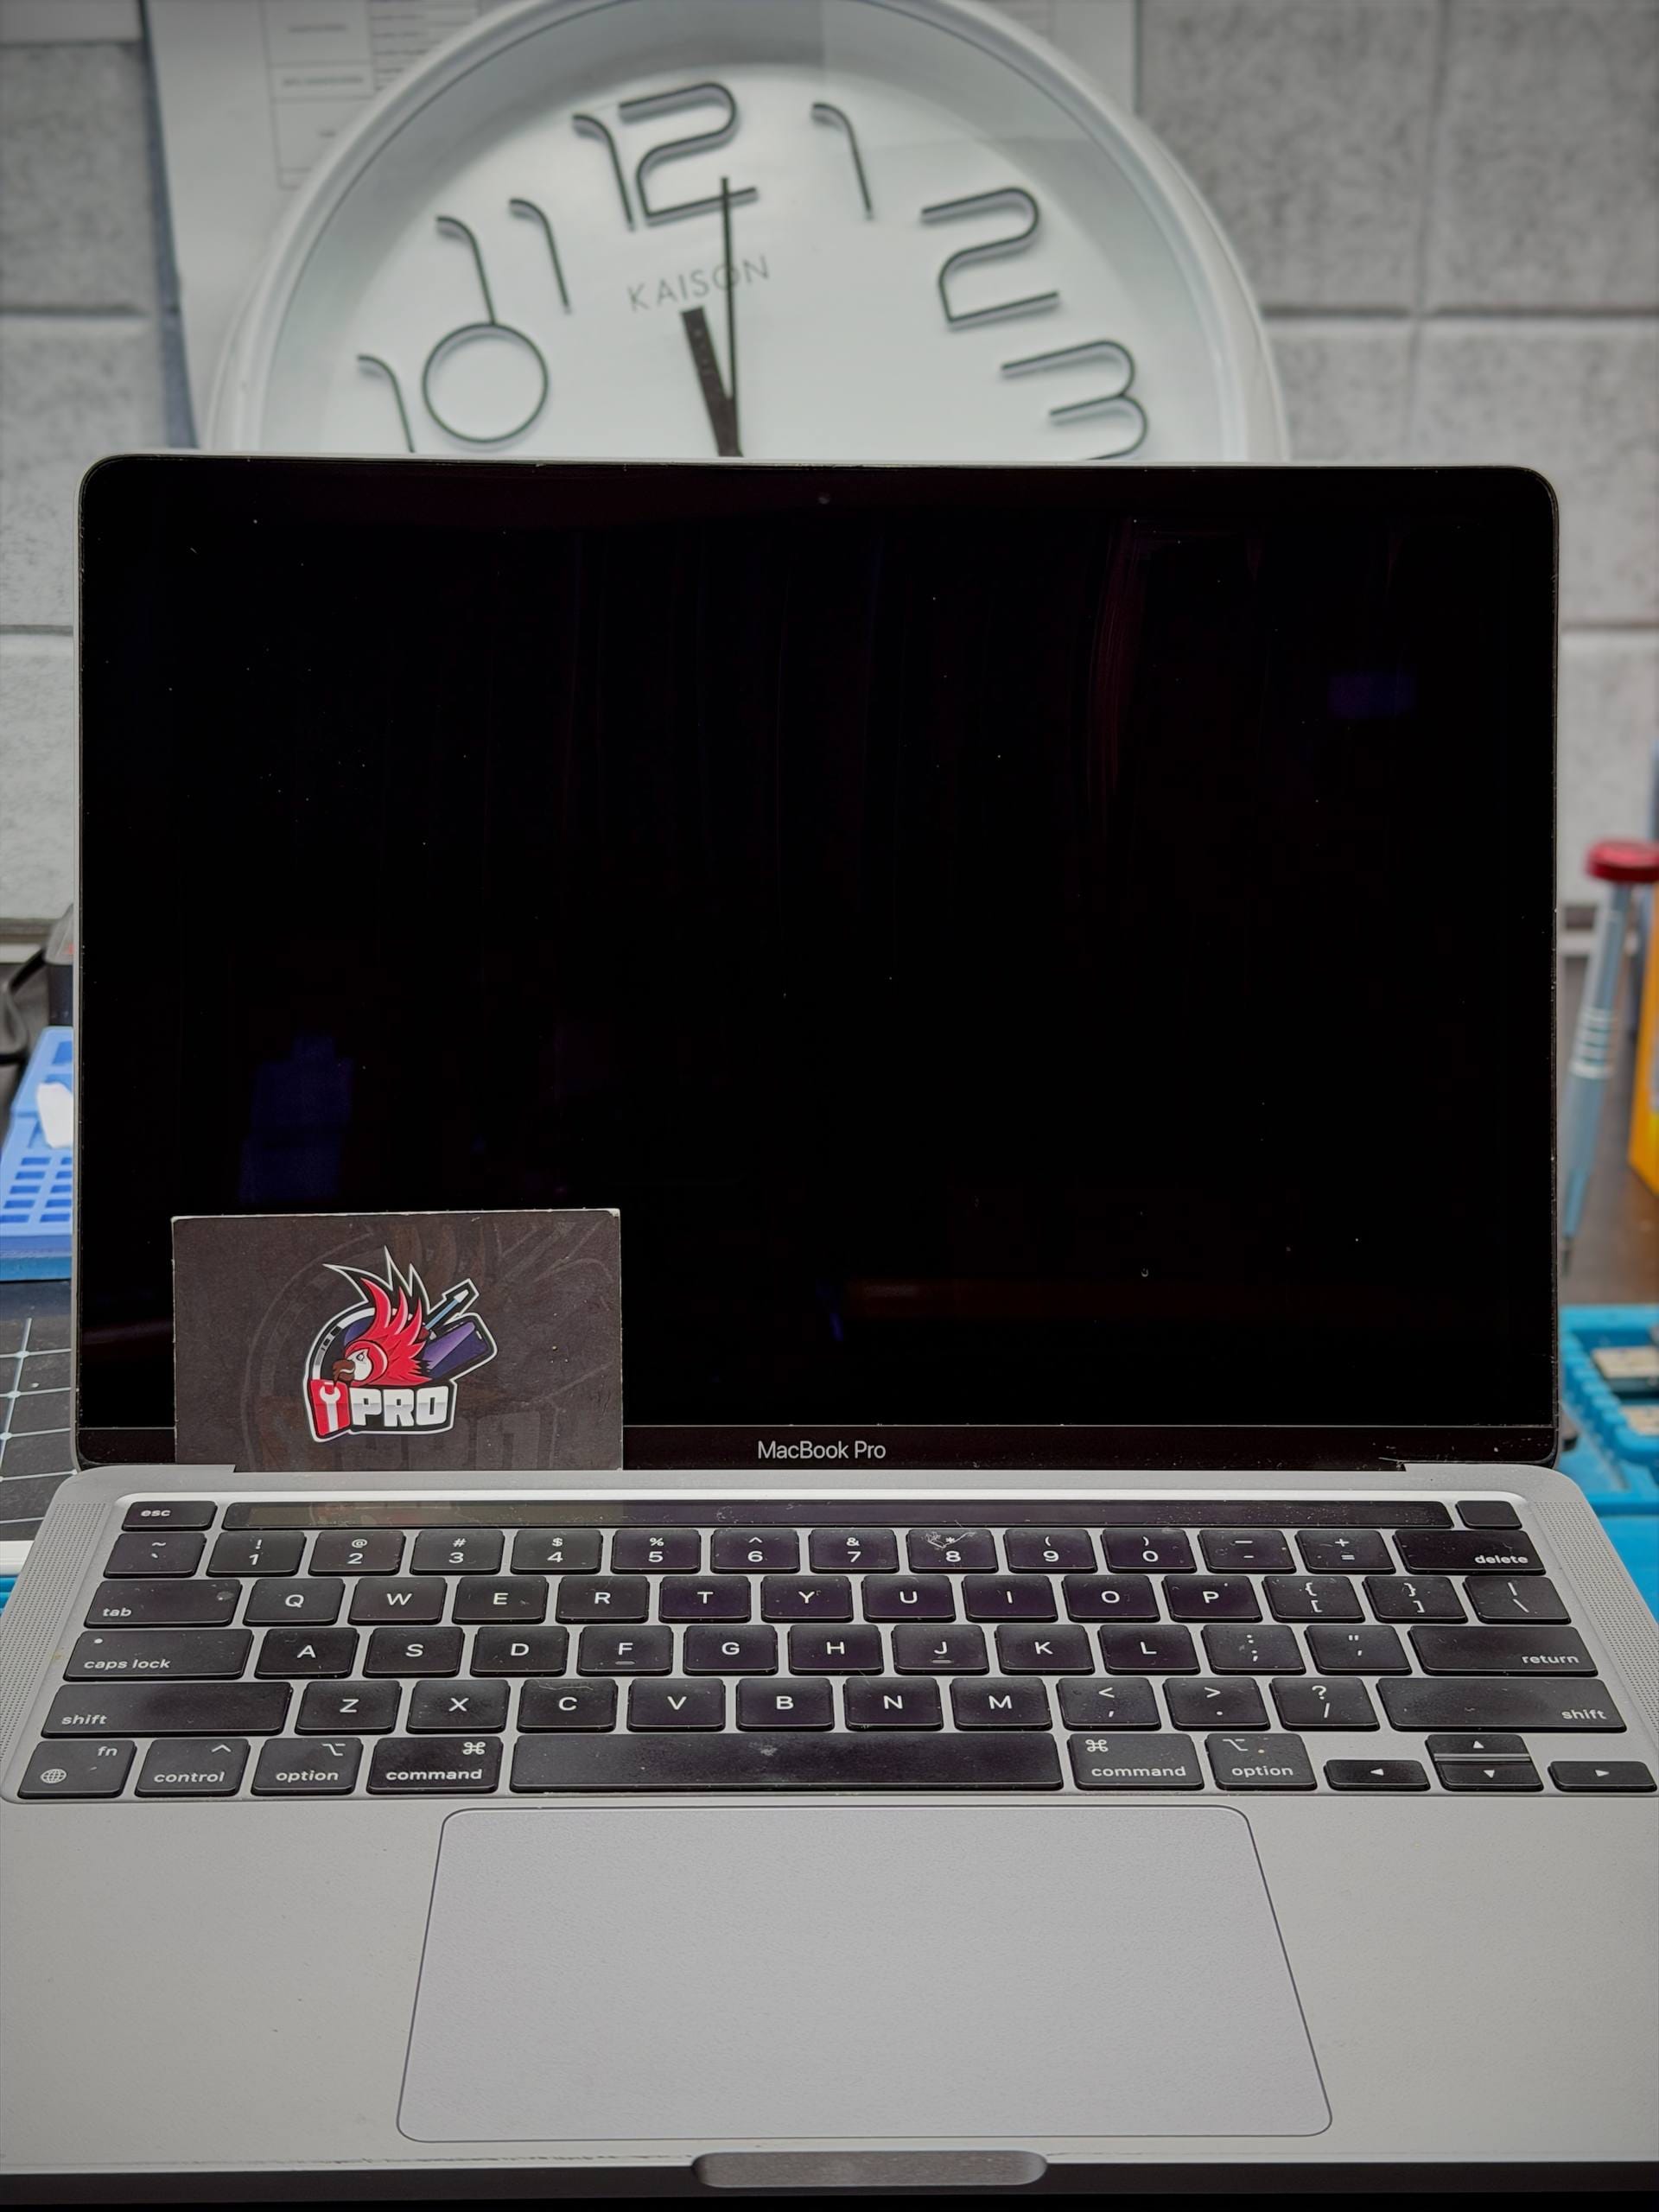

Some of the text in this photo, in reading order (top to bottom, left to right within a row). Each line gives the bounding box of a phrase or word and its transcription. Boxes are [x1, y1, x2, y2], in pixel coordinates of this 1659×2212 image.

[572, 82, 759, 232] 12
[812, 103, 874, 221] 1
[436, 197, 573, 325] 11
[921, 186, 1061, 333] 2
[626, 254, 771, 314] KAISON
[1001, 340, 1147, 461] 3
[758, 1440, 887, 1459] MacBook Pro
[249, 1554, 259, 1566] 1
[346, 1552, 364, 1565] 2
[448, 1552, 464, 1564] 3
[547, 1551, 563, 1563] 4
[648, 1551, 664, 1563] 5
[747, 1550, 764, 1563] 6
[847, 1551, 861, 1563] 7
[945, 1550, 962, 1563] 8
[1043, 1550, 1059, 1562] 9
[1142, 1550, 1159, 1562] 0
[1474, 1554, 1529, 1564] delete
[284, 1594, 304, 1608] Q
[386, 1592, 412, 1605] W
[493, 1592, 509, 1605] E
[594, 1592, 611, 1605] R
[696, 1591, 714, 1605] T
[798, 1591, 815, 1604] Y
[899, 1591, 918, 1604] U
[1007, 1591, 1013, 1604] I
[1101, 1590, 1121, 1604] O
[1202, 1591, 1219, 1604] P
[102, 1607, 132, 1617] tab
[296, 1644, 316, 1658] A
[405, 1643, 424, 1657] S
[510, 1643, 530, 1656] D
[618, 1642, 633, 1656] F
[721, 1642, 741, 1656] G
[826, 1641, 845, 1655] H
[933, 1641, 948, 1655] J
[1034, 1641, 1053, 1655] K
[1140, 1641, 1157, 1655] L
[84, 1658, 171, 1670] caps lock
[1522, 1655, 1580, 1664] return
[339, 1698, 359, 1713] Z
[448, 1697, 469, 1712] X
[558, 1696, 578, 1711] C
[667, 1695, 687, 1710] V
[776, 1695, 794, 1710] B
[883, 1695, 903, 1710] N
[988, 1694, 1013, 1710] M
[61, 1714, 107, 1725] shift
[1561, 1709, 1607, 1719] shift
[98, 1745, 118, 1757] fn
[154, 1771, 226, 1783] control
[276, 1770, 339, 1783] option
[385, 1768, 483, 1781] command
[1091, 1765, 1186, 1777] command
[1231, 1765, 1294, 1778] option
